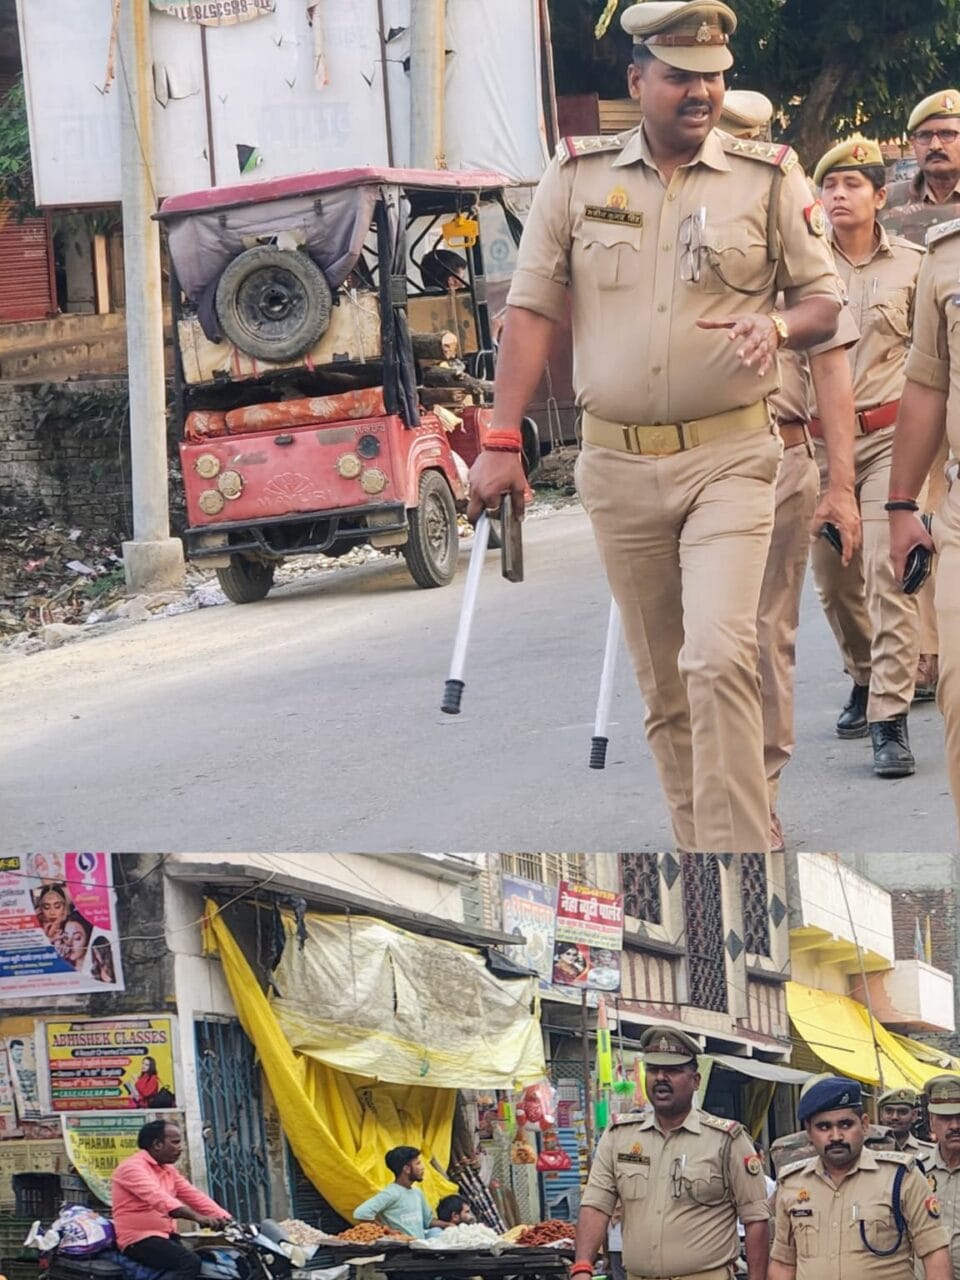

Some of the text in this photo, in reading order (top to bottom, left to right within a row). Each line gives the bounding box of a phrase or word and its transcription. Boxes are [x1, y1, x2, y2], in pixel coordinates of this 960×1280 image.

[560, 891, 578, 914] नेहा
[579, 897, 598, 921] ब्यूटी
[599, 901, 622, 922] पार्लर
[52, 1030, 167, 1047] ABHISHEK CLASSES
[78, 1136, 116, 1149] PHARMA
